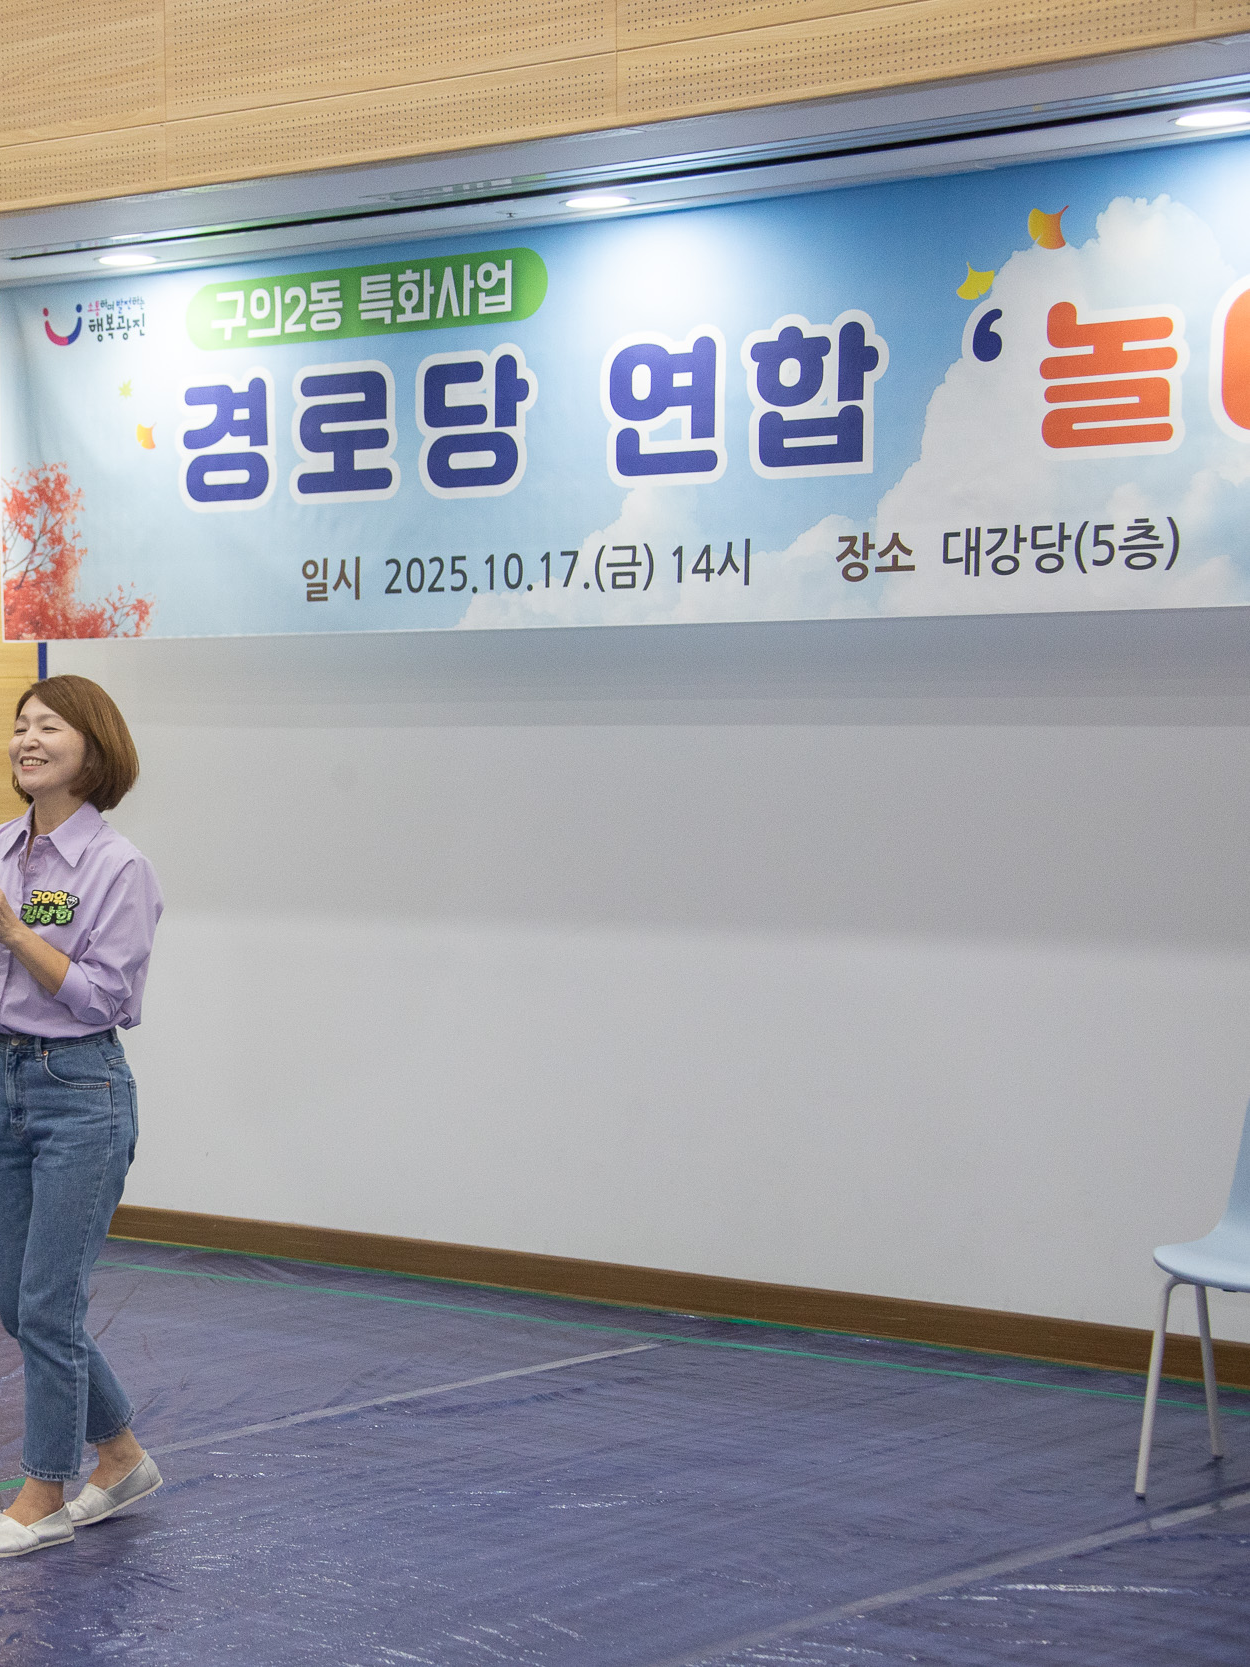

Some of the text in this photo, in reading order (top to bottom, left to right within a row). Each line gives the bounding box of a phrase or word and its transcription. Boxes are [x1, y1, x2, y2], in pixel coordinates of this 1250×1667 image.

[88, 313, 145, 342] 행복광진
[211, 259, 513, 341] 구의2동 특화사업
[182, 354, 530, 503] 경로당
[608, 320, 879, 477] 연합
[301, 516, 1182, 602] 일시 2025.10.17.(금) 14시 장소 대강당(5층)
[31, 890, 68, 906] 구의원
